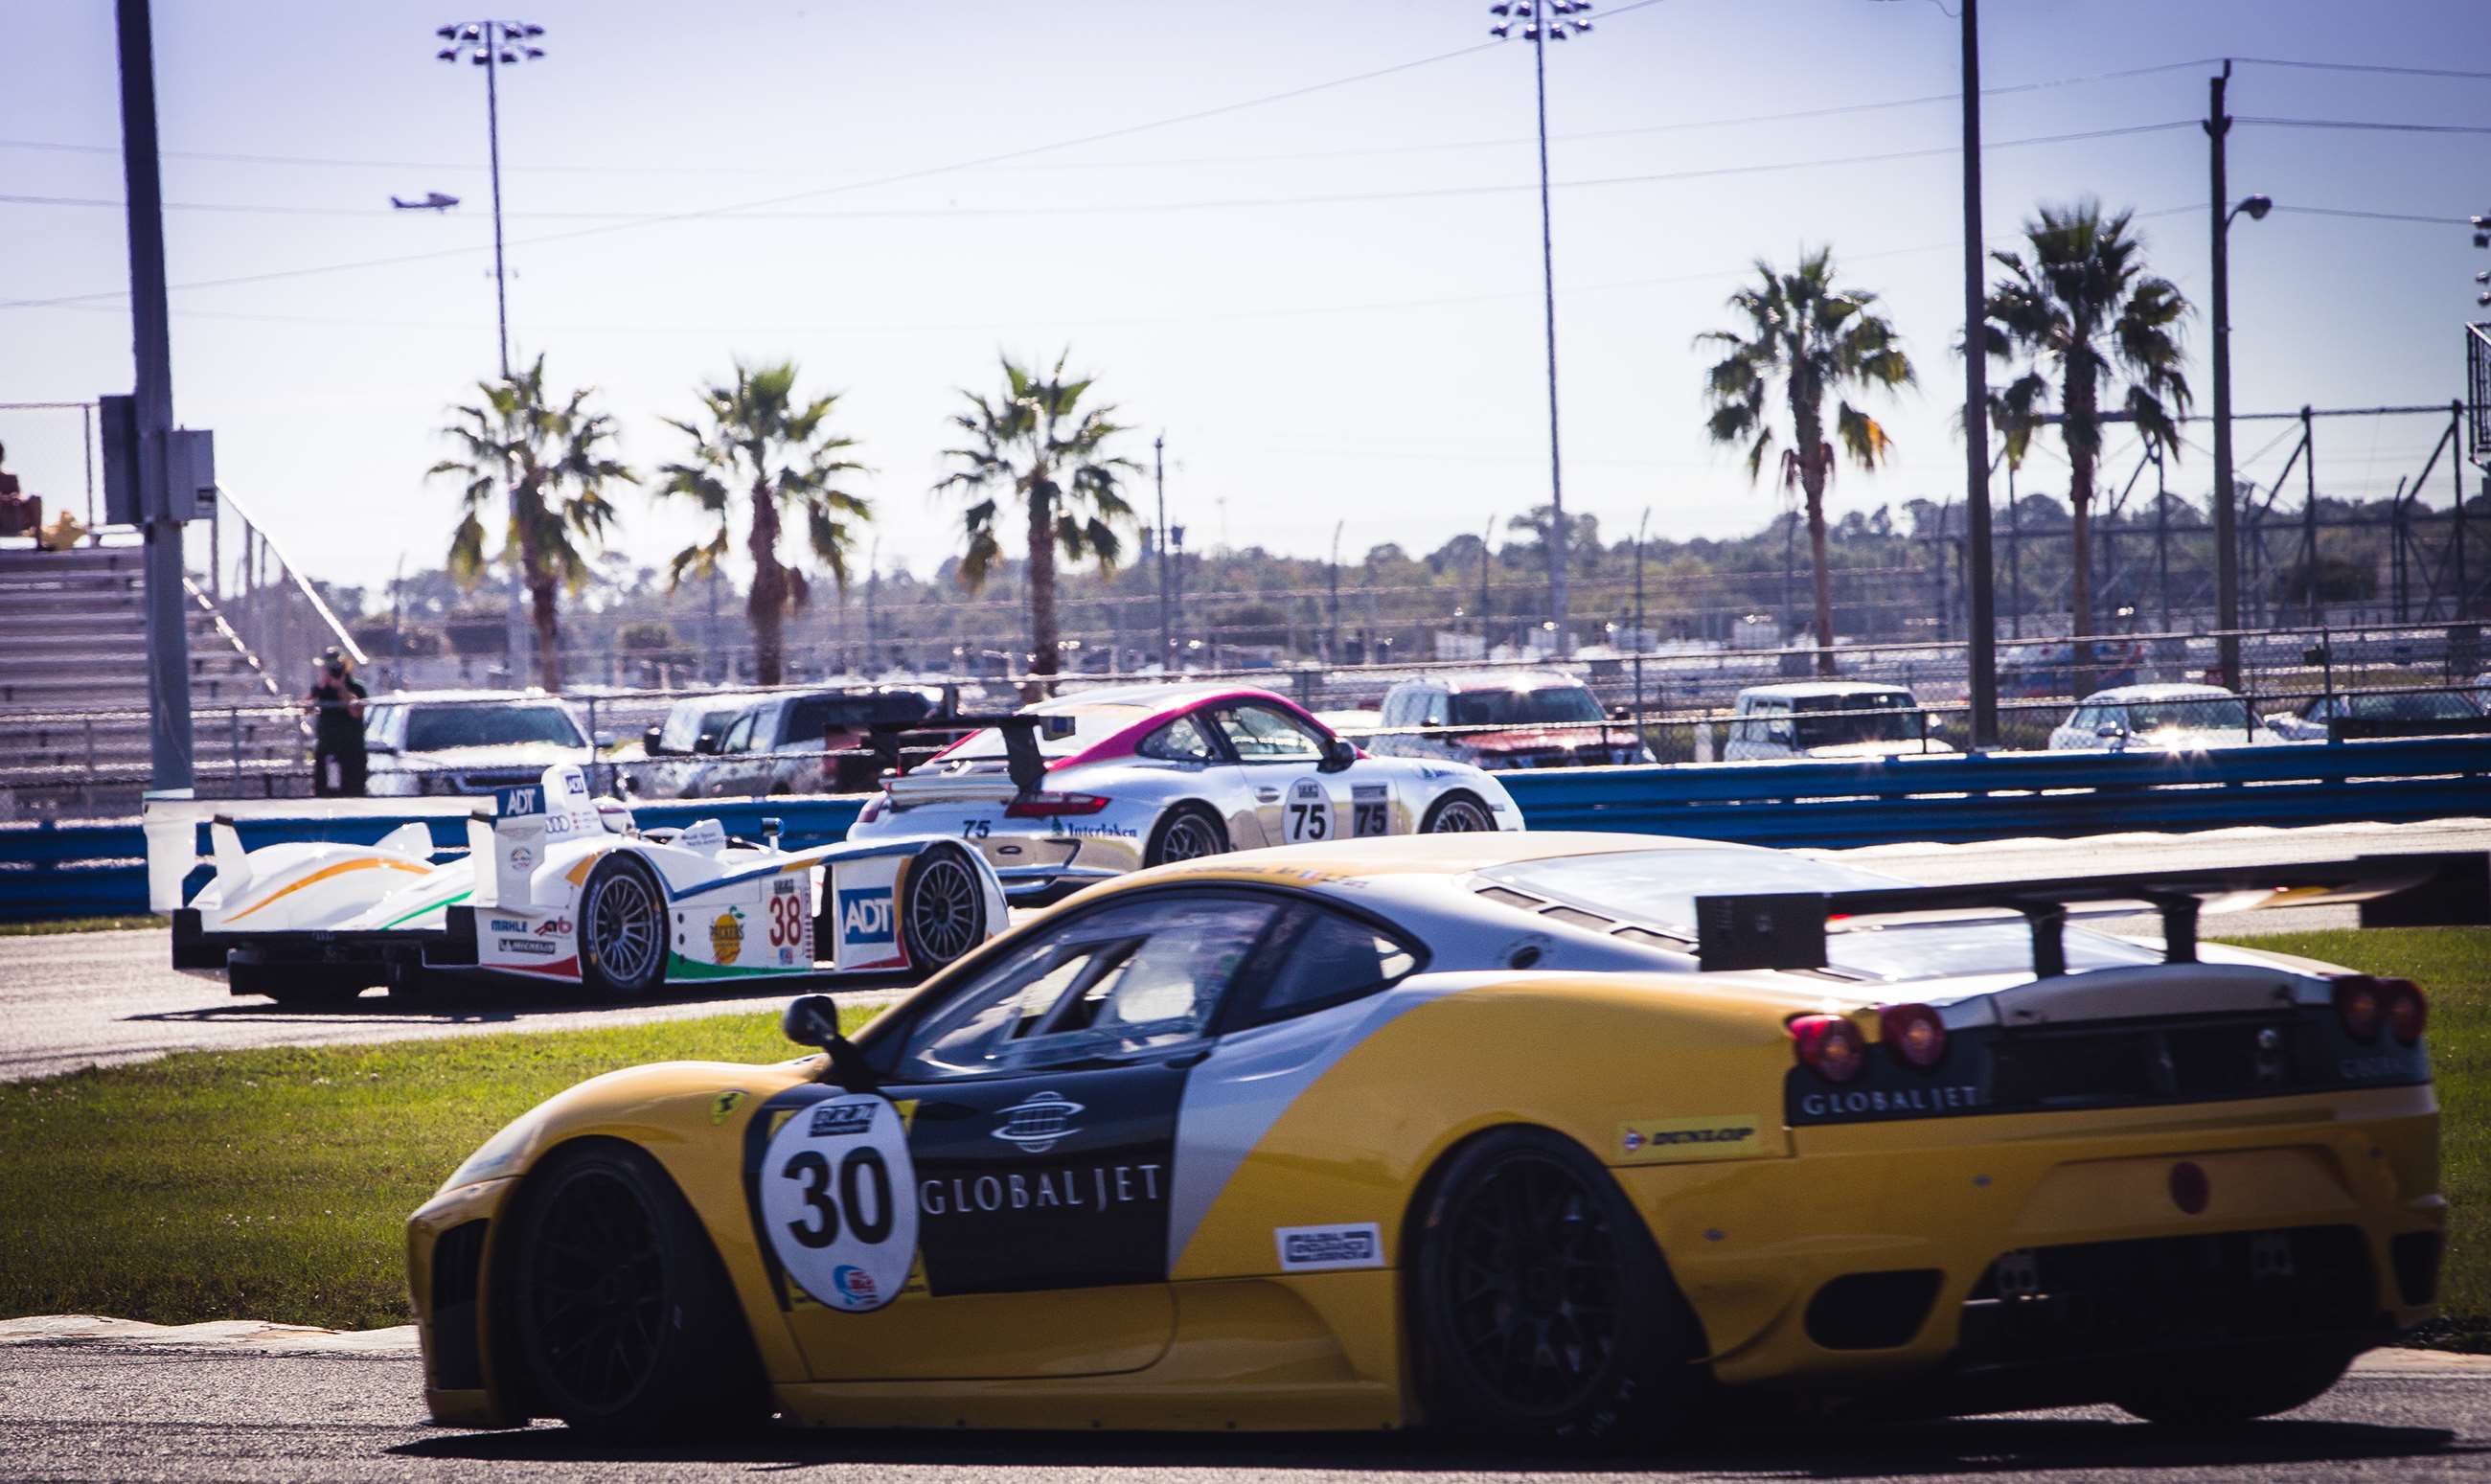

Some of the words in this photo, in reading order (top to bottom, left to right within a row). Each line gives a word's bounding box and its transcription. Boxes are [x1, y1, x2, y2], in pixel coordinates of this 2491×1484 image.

[506, 788, 536, 815] ADT
[963, 819, 991, 839] 75
[1291, 803, 1326, 840] 75
[1356, 804, 1386, 834] 75
[491, 919, 528, 932] MAHLE
[769, 896, 801, 947] 38
[845, 898, 891, 934] ADT
[1801, 1089, 1928, 1116] GLOBAL
[1930, 1085, 1978, 1112] JET
[1652, 1127, 1755, 1146] DUNLOP
[782, 1146, 894, 1248] 30
[919, 1171, 1084, 1215] GLOBAL
[1093, 1165, 1161, 1212] JET
